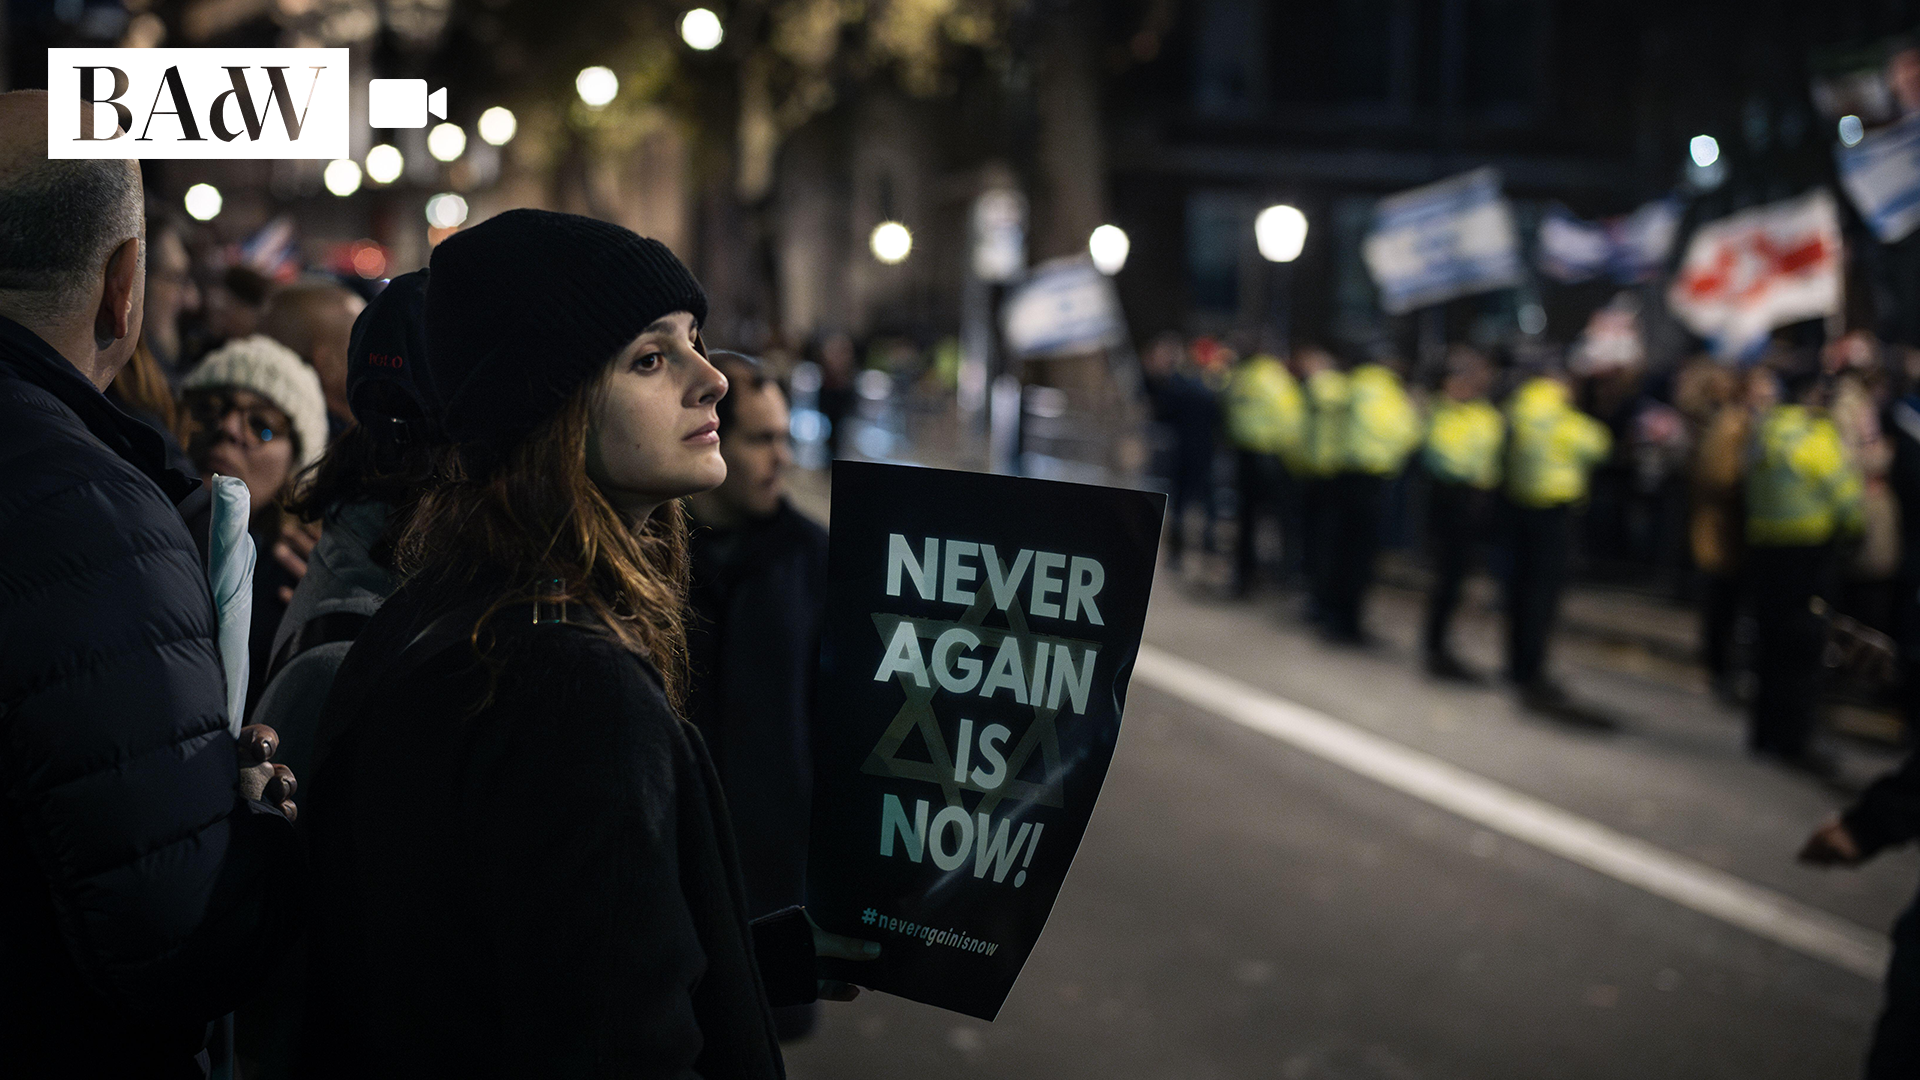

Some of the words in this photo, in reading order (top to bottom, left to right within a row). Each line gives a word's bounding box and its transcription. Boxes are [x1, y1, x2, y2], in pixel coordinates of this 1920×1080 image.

[886, 533, 1105, 626] NEVER
[874, 622, 1098, 715] AGAIN
[954, 719, 1012, 790] IS
[880, 793, 1044, 888] NOW!
[861, 907, 999, 957] #neveragainisnow
